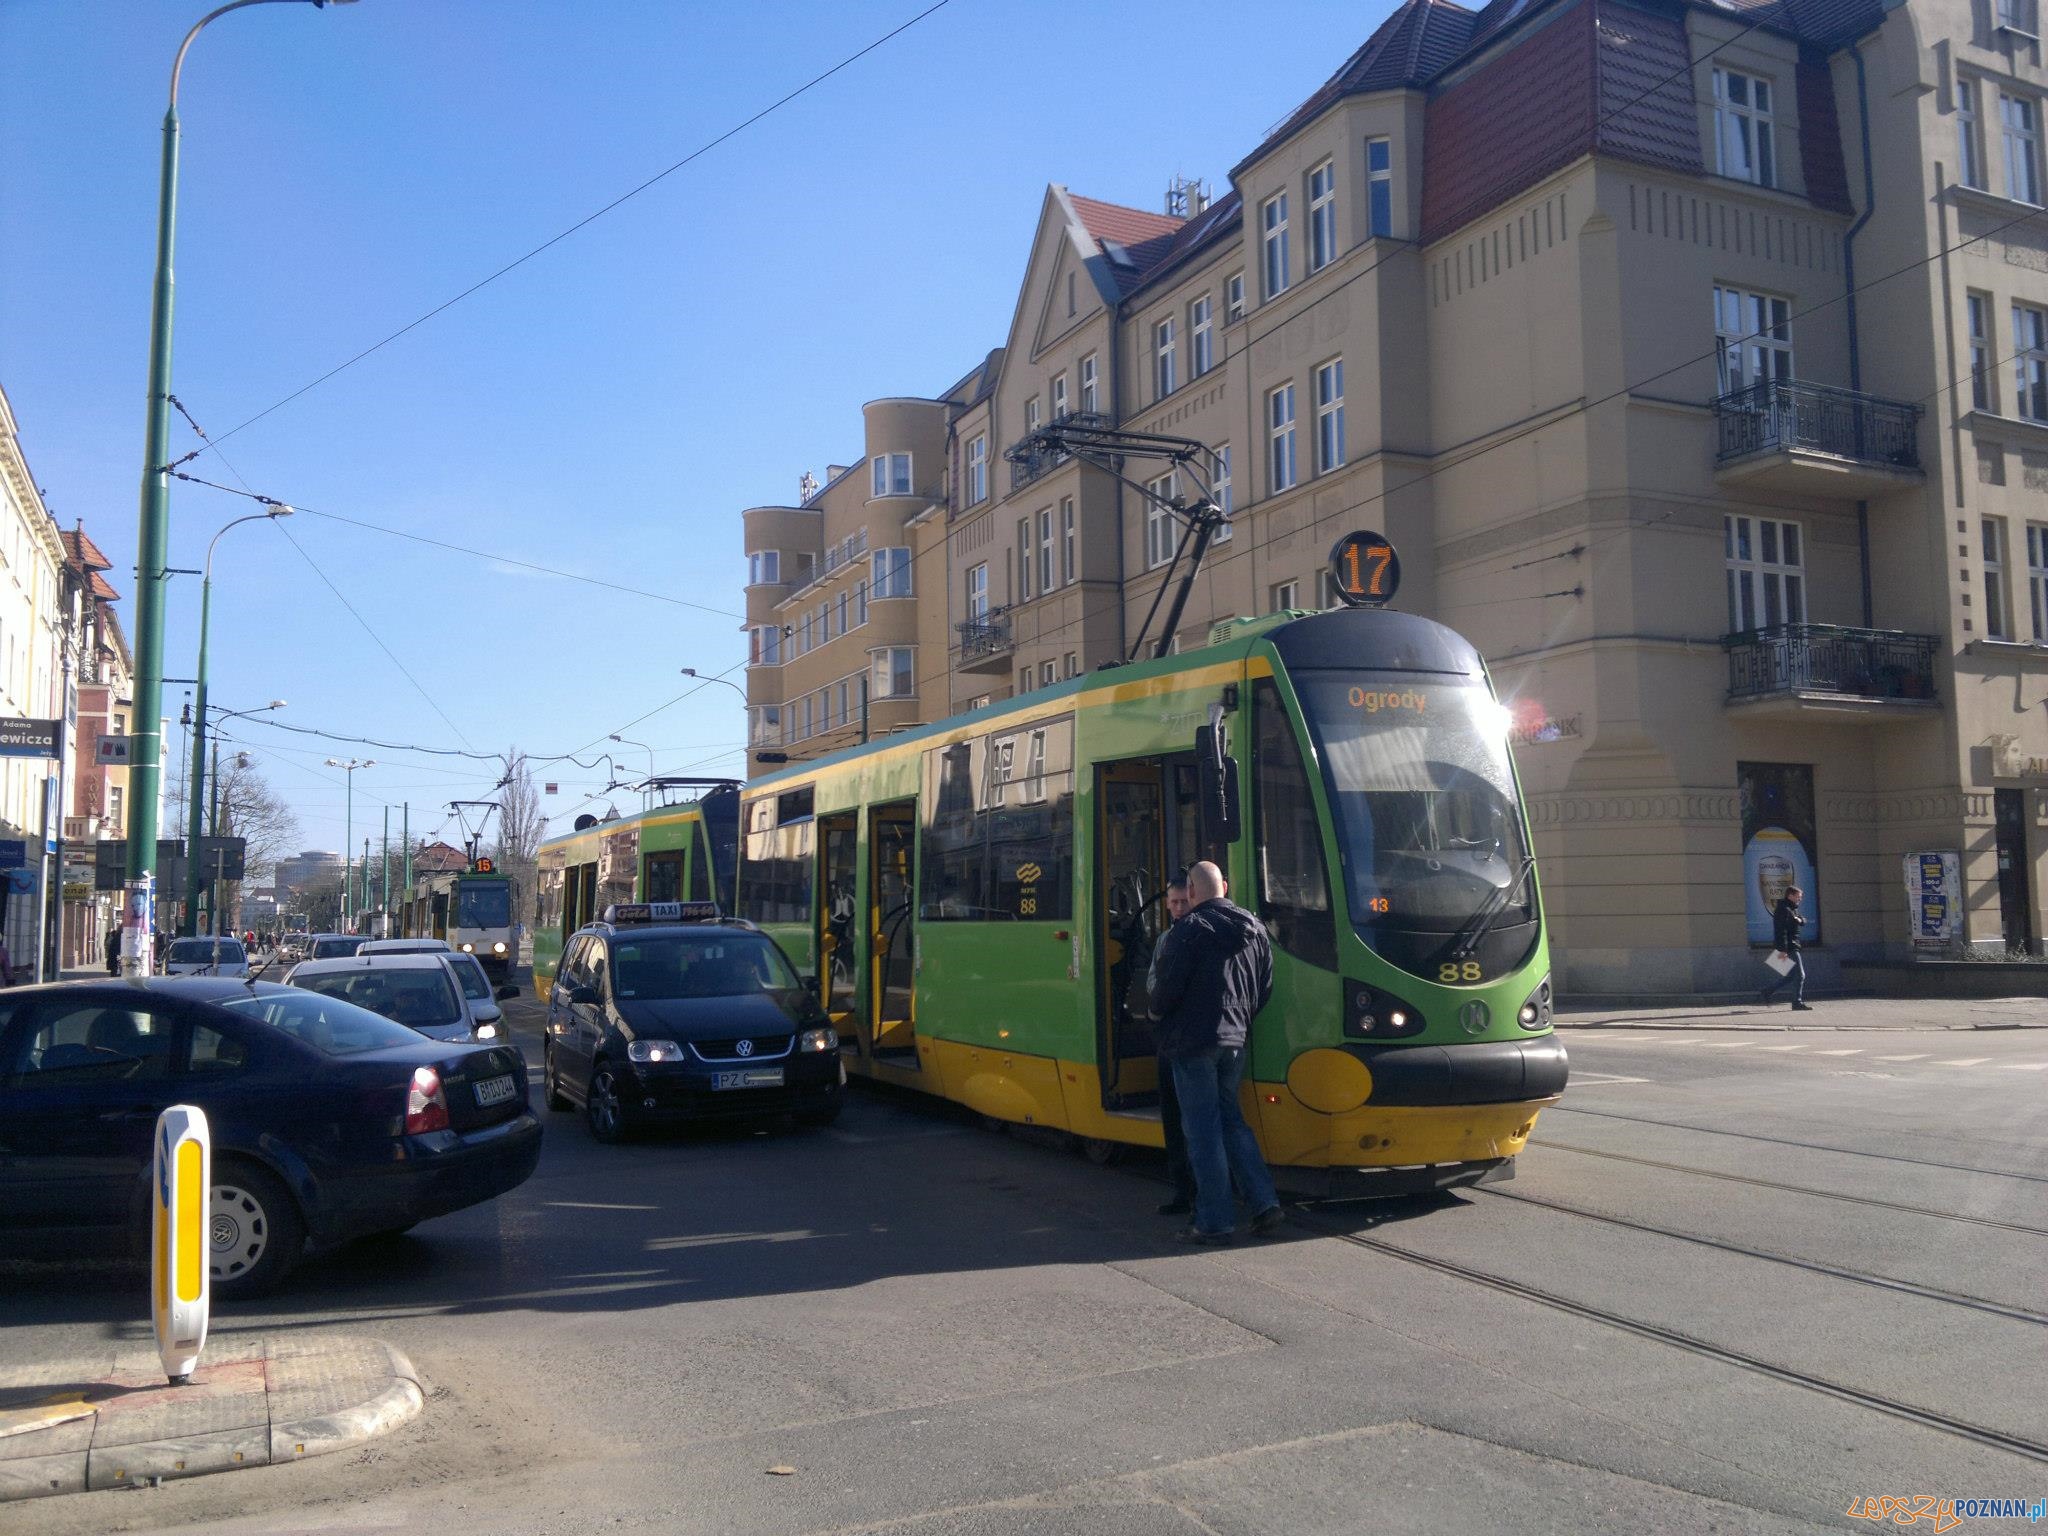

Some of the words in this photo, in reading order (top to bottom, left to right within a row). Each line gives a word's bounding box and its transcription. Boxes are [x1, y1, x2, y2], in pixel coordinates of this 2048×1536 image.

[1344, 543, 1391, 595] 17
[1348, 686, 1425, 715] Ogrody
[3, 720, 32, 728] Adama
[477, 859, 491, 872] 15
[655, 904, 678, 916] TAXI
[1020, 898, 1036, 914] 88
[1439, 962, 1482, 982] 88
